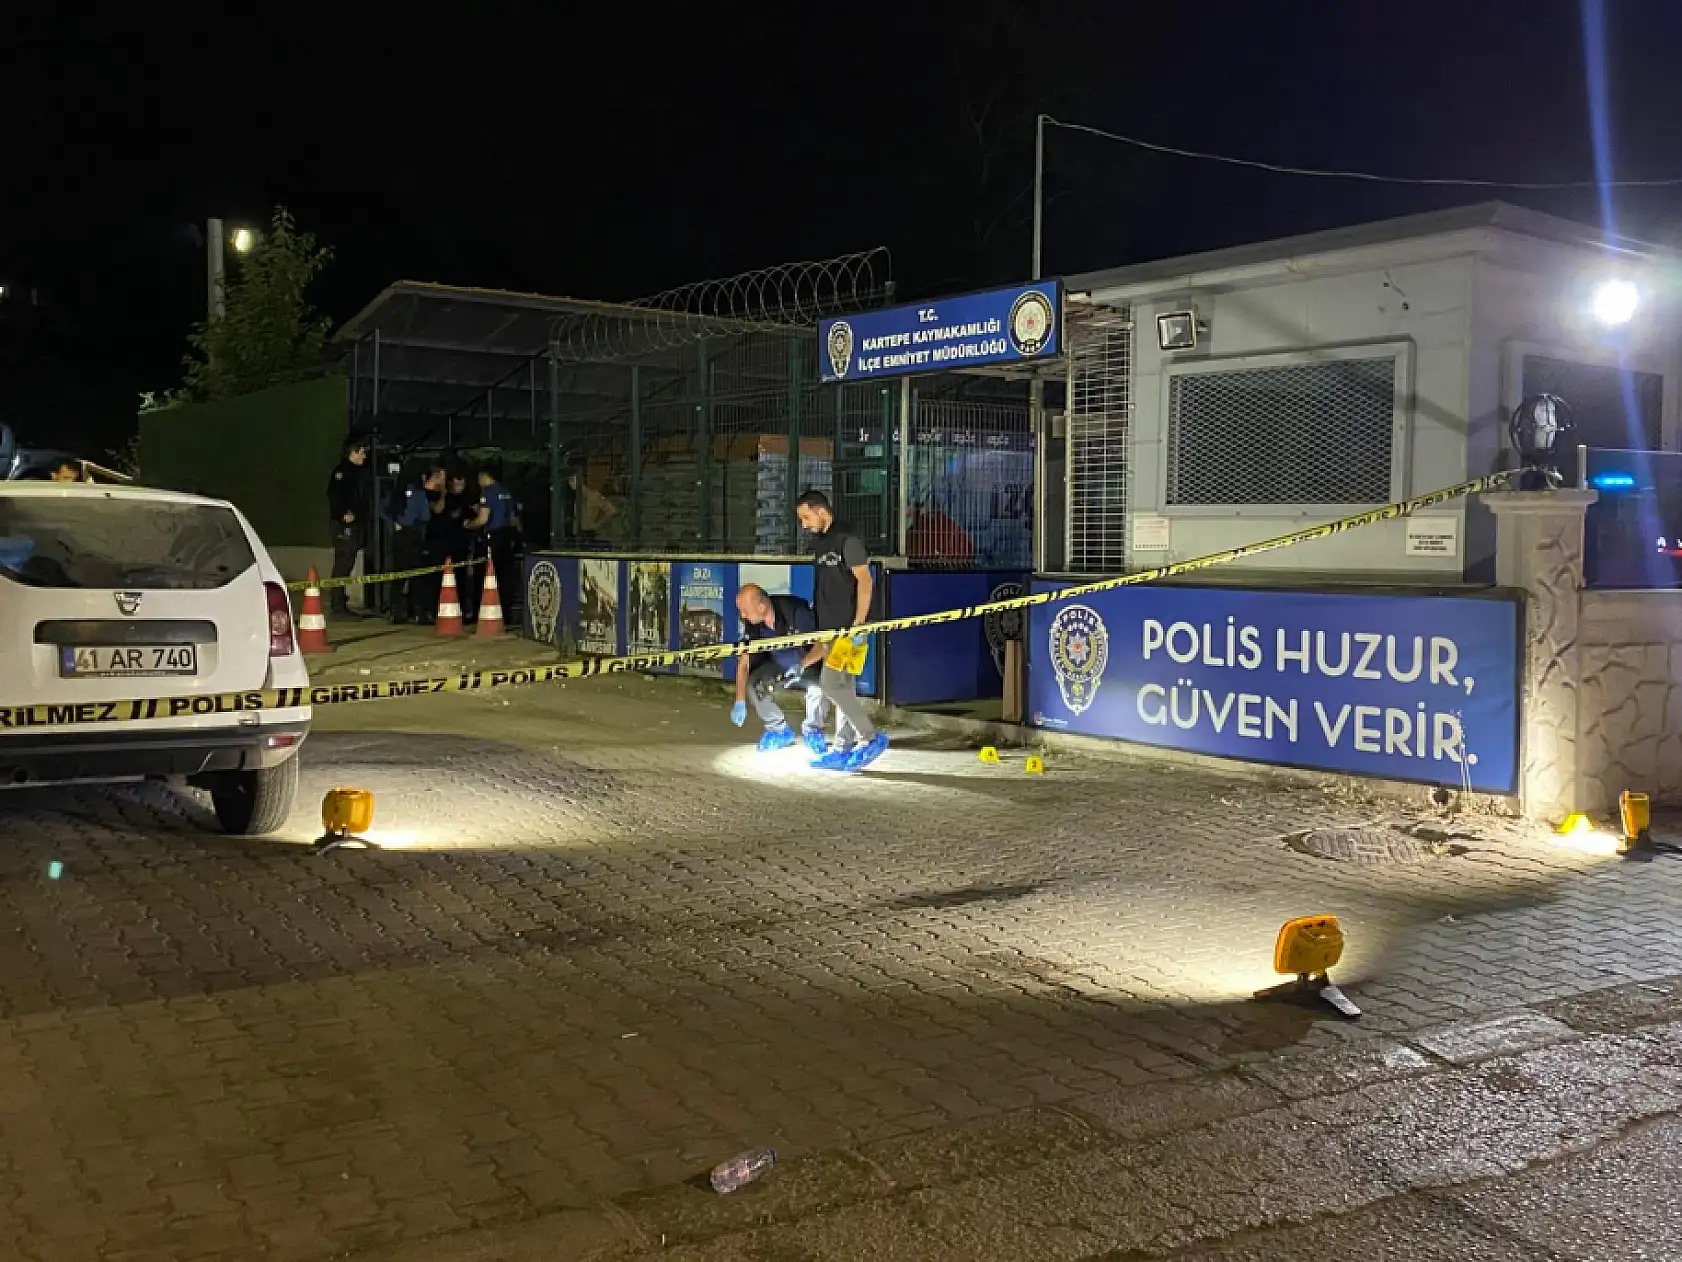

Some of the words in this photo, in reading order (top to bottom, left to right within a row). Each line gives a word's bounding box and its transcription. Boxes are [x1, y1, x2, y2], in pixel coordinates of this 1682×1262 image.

[857, 356, 881, 372] İLÇE
[883, 350, 930, 368] EMNİYET
[932, 338, 1007, 362] MÜDÜRLÜĞÜ
[862, 332, 910, 352] KARTEPE
[912, 317, 1000, 345] KAYMAKAMLIĞI
[75, 648, 98, 669] 41
[109, 648, 143, 669] AR
[152, 648, 192, 669] 740
[1142, 616, 1262, 670] POLİS
[1276, 628, 1476, 696] HUZUR,
[169, 689, 265, 717] POLİS
[310, 677, 448, 705] GİRİLMEZ
[490, 665, 570, 687] POLİS
[1136, 679, 1298, 742] GÜVEN
[1314, 702, 1479, 766] VERİR.
